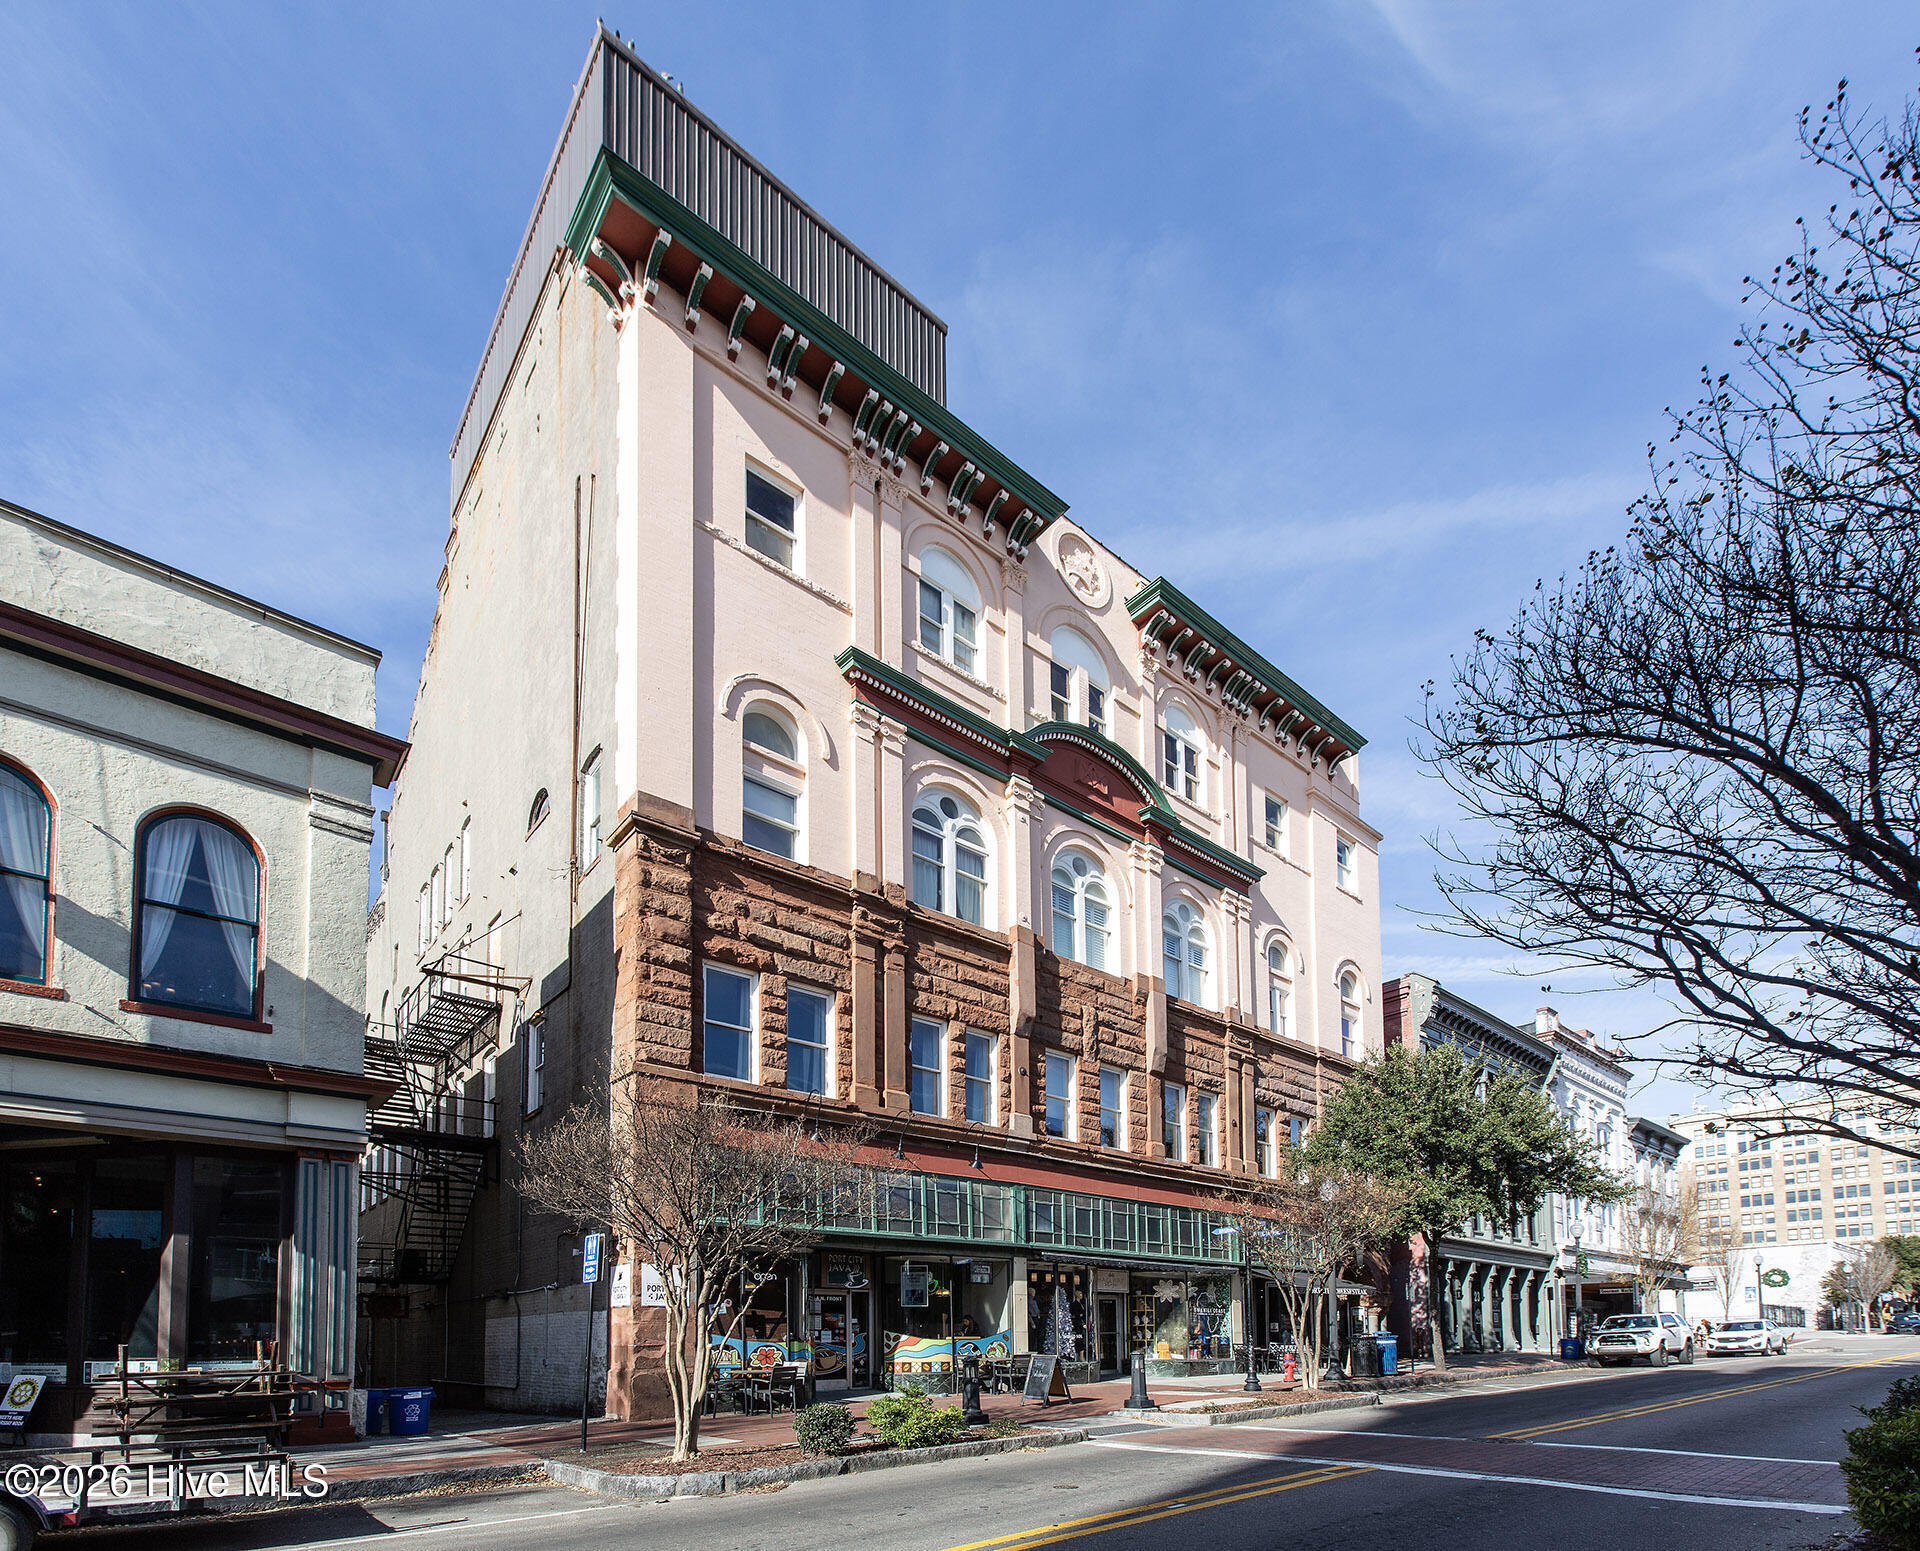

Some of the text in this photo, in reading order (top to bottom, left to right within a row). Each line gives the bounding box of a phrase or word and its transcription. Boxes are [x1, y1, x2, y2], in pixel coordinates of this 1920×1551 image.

[848, 1255, 863, 1264] CITY
[828, 1264, 852, 1272] JAVA
[753, 1272, 777, 1282] open
[1473, 1291, 1481, 1302] 23
